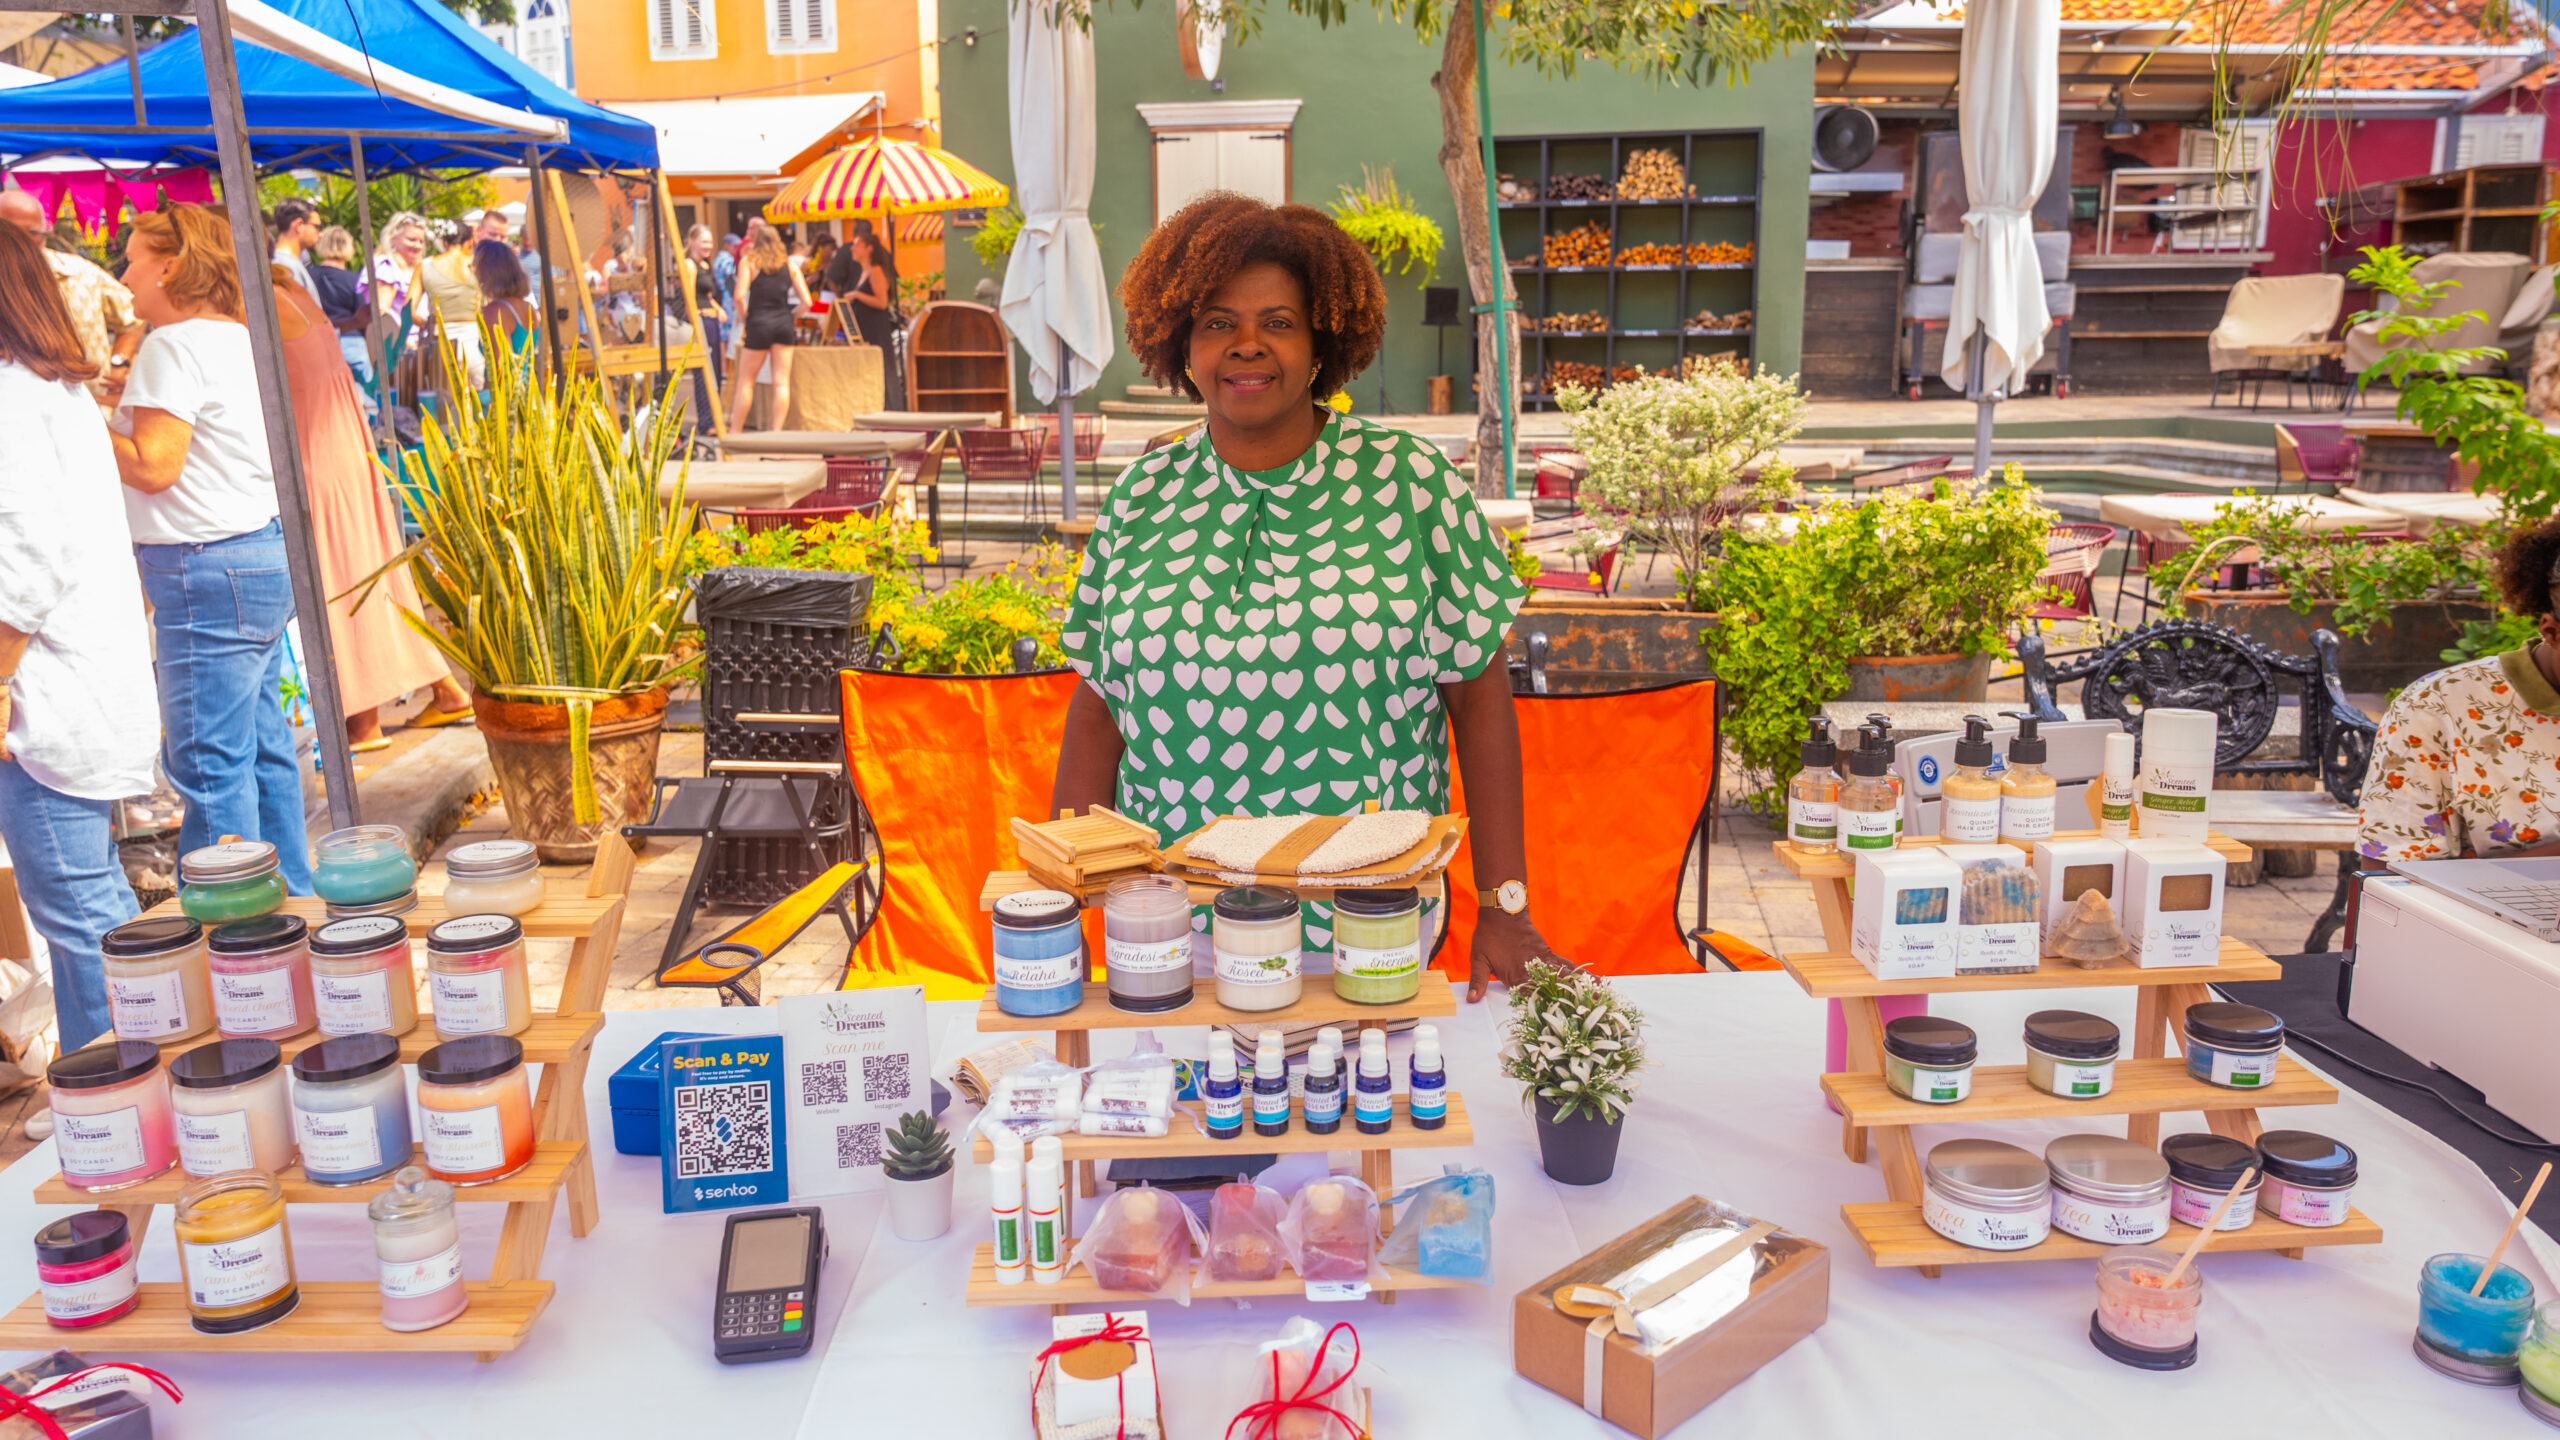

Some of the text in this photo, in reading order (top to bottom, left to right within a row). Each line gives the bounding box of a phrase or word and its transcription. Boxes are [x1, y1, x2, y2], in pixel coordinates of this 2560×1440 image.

[2160, 781, 2196, 791] Dreams
[2150, 796, 2198, 806] Ginger Relief
[1806, 815, 1832, 823] Dreams
[1227, 965, 1265, 977] Rosea
[228, 990, 264, 999] Dreams
[327, 992, 362, 1000] Dreams
[444, 991, 478, 999] Dreams
[120, 996, 156, 1005] Dreams
[239, 1015, 267, 1023] CANDLE
[846, 1011, 884, 1021] Scented
[128, 1019, 159, 1027] CANDLE
[836, 1020, 886, 1031] Dreams
[823, 1040, 885, 1056] Scan me
[673, 1052, 770, 1069] Scan & Pay
[1306, 1095, 1331, 1103] Scented
[875, 1101, 903, 1110] Instagram
[816, 1107, 840, 1116] Website
[73, 1131, 112, 1140] Dreams
[186, 1132, 220, 1140] Dreams
[312, 1128, 348, 1137] Dreams
[437, 1128, 472, 1137] Dreams
[84, 1156, 114, 1165] CANDLE
[705, 1182, 758, 1199] sentoo
[2186, 1199, 2211, 1210] Dreams
[1937, 1205, 1967, 1229] Tea
[2062, 1202, 2093, 1225] Tea
[2126, 1221, 2153, 1229] Scented
[2000, 1226, 2028, 1234] Scented
[2117, 1227, 2154, 1237] Dreams
[1990, 1232, 2028, 1241] Dreams
[221, 1253, 263, 1269] Dreams
[213, 1279, 265, 1296] SOY CANDLE
[63, 1304, 91, 1313] CANDLE
[74, 1377, 130, 1393] Dreams
